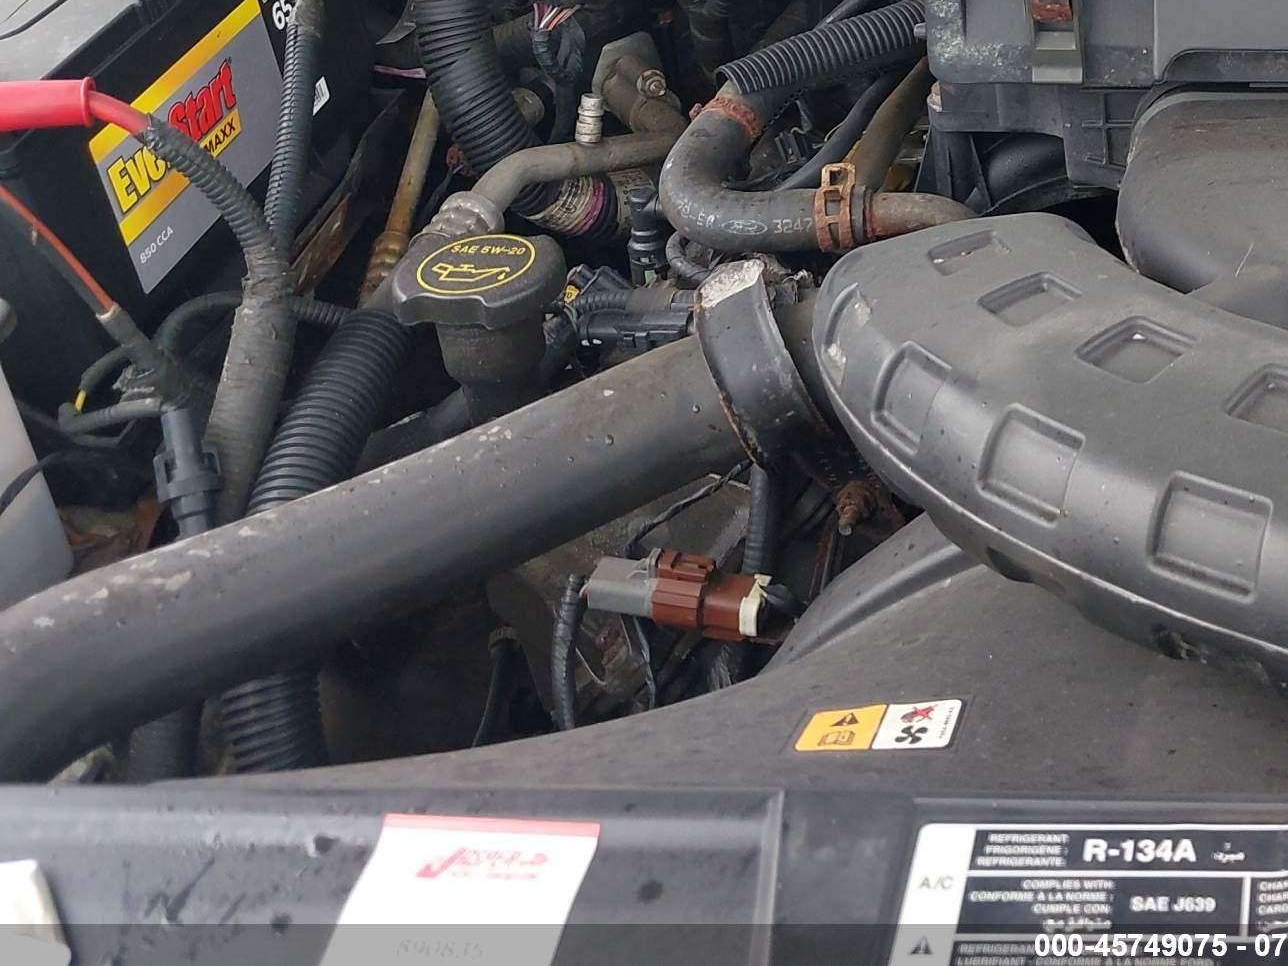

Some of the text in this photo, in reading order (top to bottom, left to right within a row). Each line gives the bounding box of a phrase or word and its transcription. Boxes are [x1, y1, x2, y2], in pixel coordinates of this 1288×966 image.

[772, 218, 813, 234] 3247
[139, 226, 174, 264] 850 CCA
[450, 245, 526, 255] SAE 5W-20
[1082, 838, 1197, 863] R-134A
[918, 877, 952, 889] A/C
[1023, 879, 1081, 890] COMPLIES
[969, 891, 1034, 902] CONFORME
[1032, 903, 1081, 914] CUMPLE
[1130, 896, 1216, 911] SAE J639
